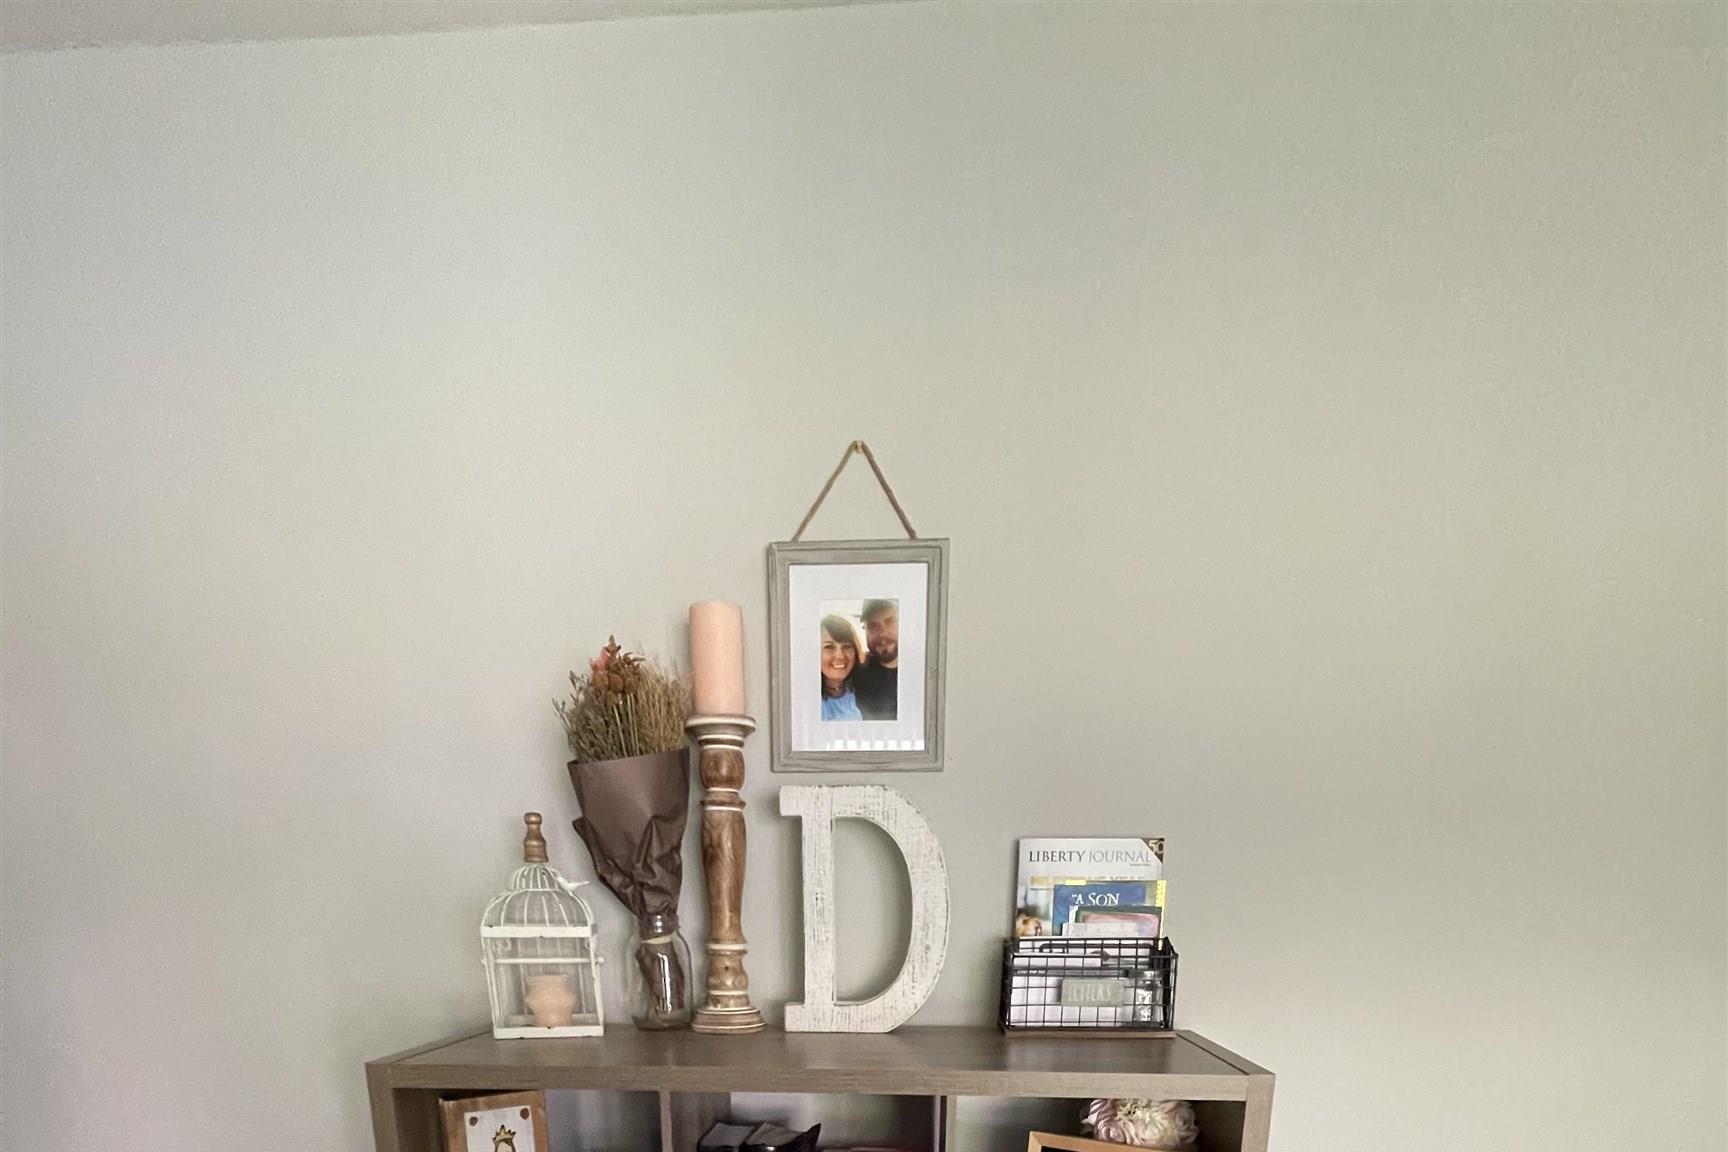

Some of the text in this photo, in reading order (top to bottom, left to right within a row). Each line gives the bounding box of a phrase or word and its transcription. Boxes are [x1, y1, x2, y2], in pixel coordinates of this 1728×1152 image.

[1029, 850, 1152, 863] LIBERTY JOURNAL
[1088, 892, 1120, 906] SON
[779, 785, 951, 1033] D
